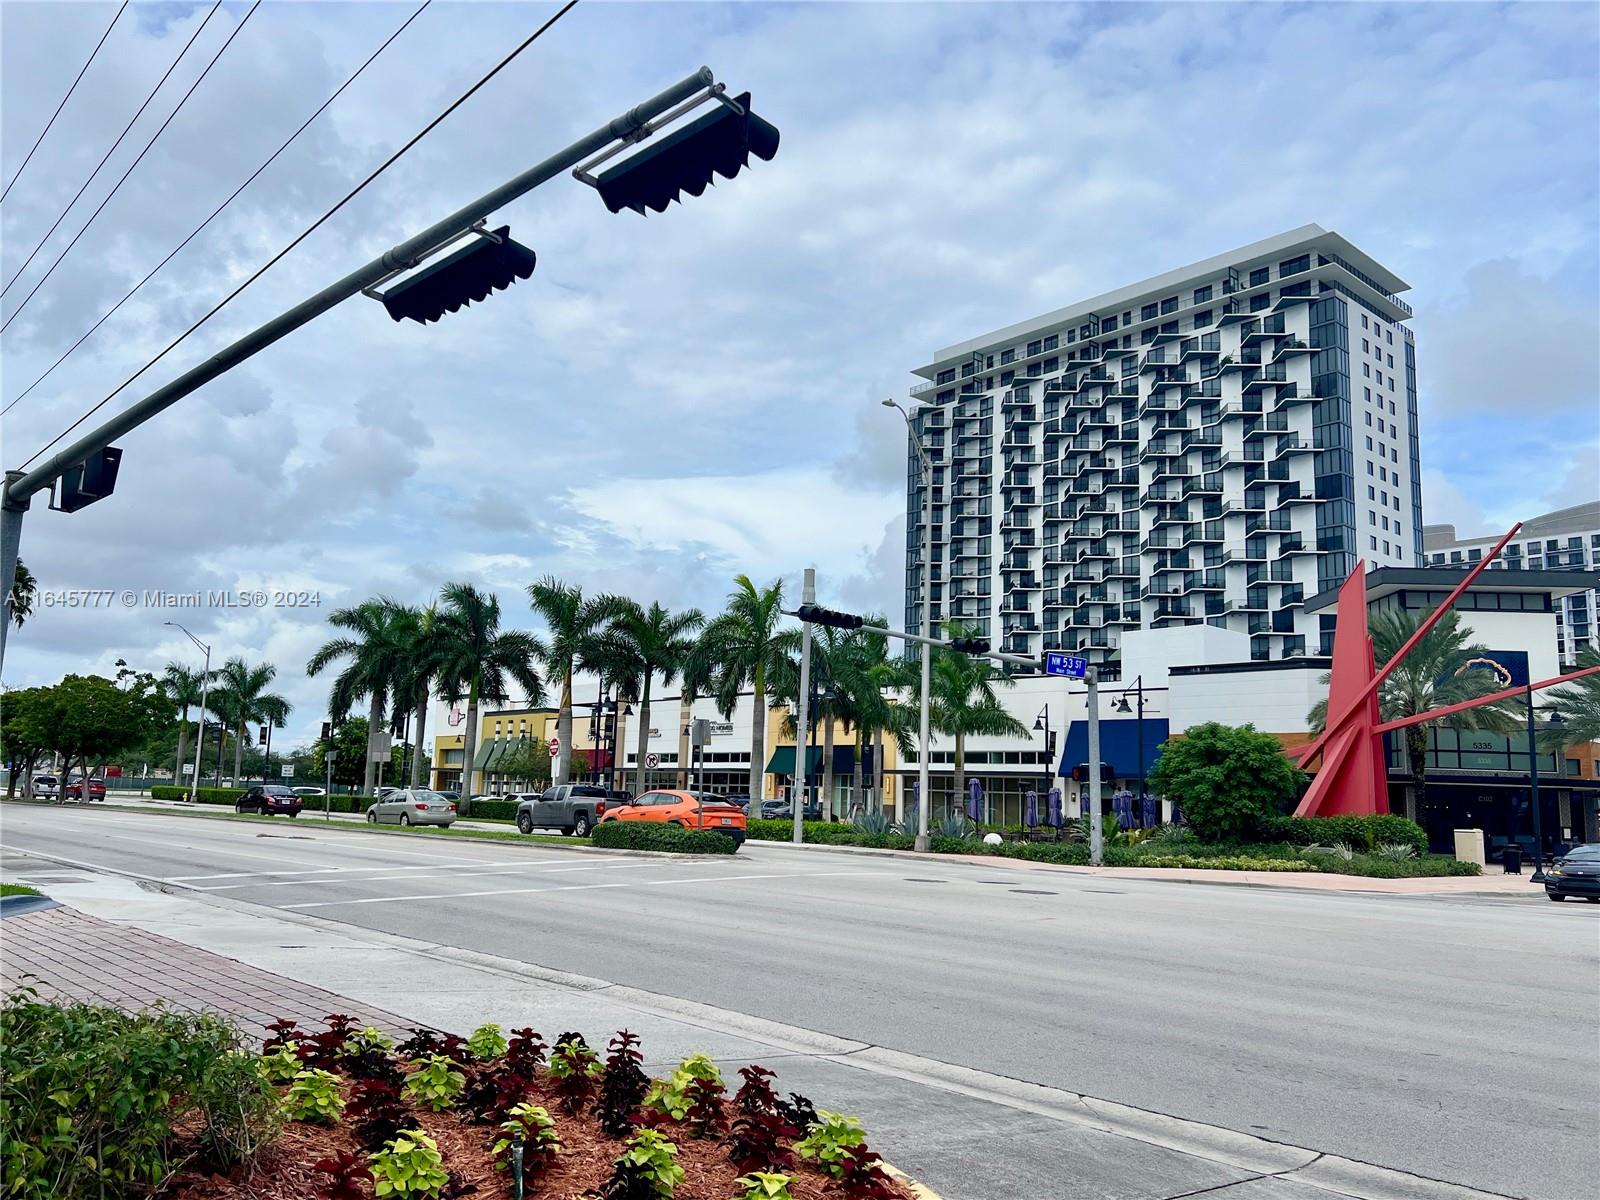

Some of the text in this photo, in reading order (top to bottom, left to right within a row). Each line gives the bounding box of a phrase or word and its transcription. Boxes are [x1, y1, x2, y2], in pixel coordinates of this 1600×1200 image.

[1051, 656, 1082, 669] NW 53 ST
[1472, 742, 1492, 750] 5335
